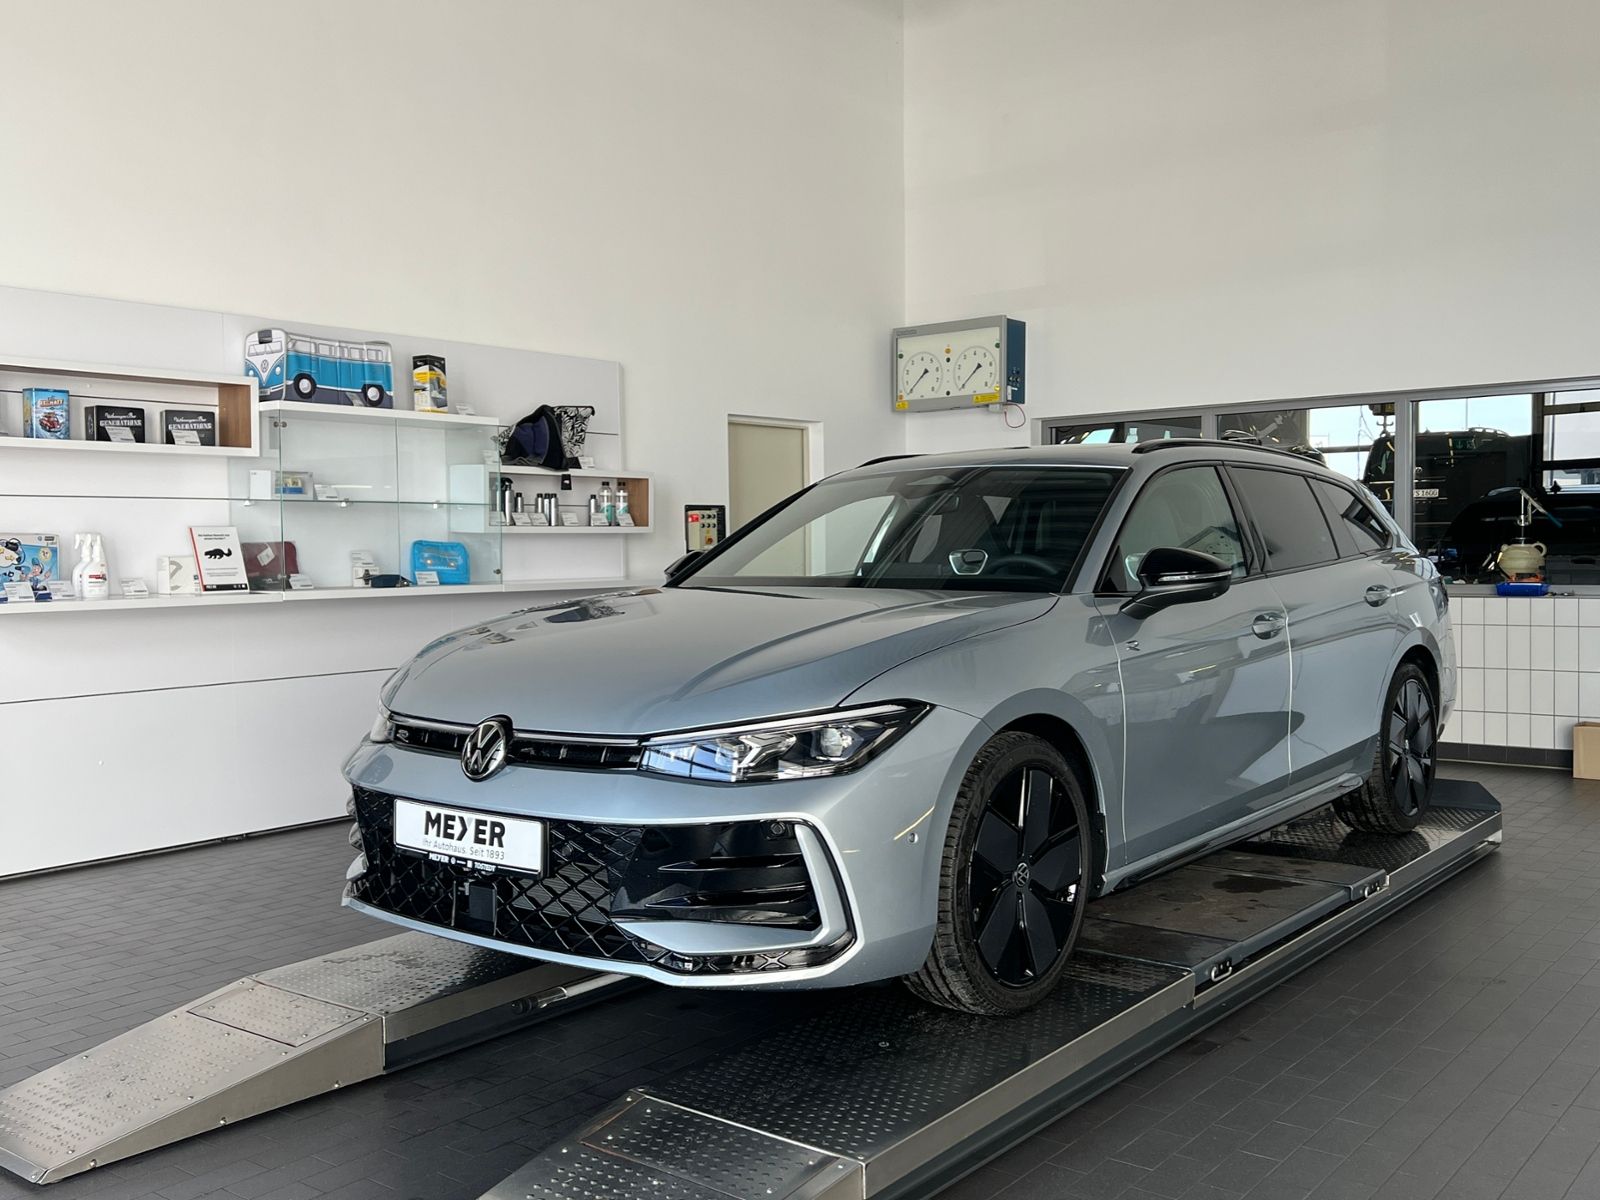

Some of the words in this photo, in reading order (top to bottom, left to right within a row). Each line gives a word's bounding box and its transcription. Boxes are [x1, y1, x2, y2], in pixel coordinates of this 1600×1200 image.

[99, 419, 142, 427] GENERATIONS
[168, 422, 212, 430] GENERATIONS
[424, 810, 506, 848] MEYER
[469, 846, 484, 858] Seit
[486, 849, 505, 860] 1893
